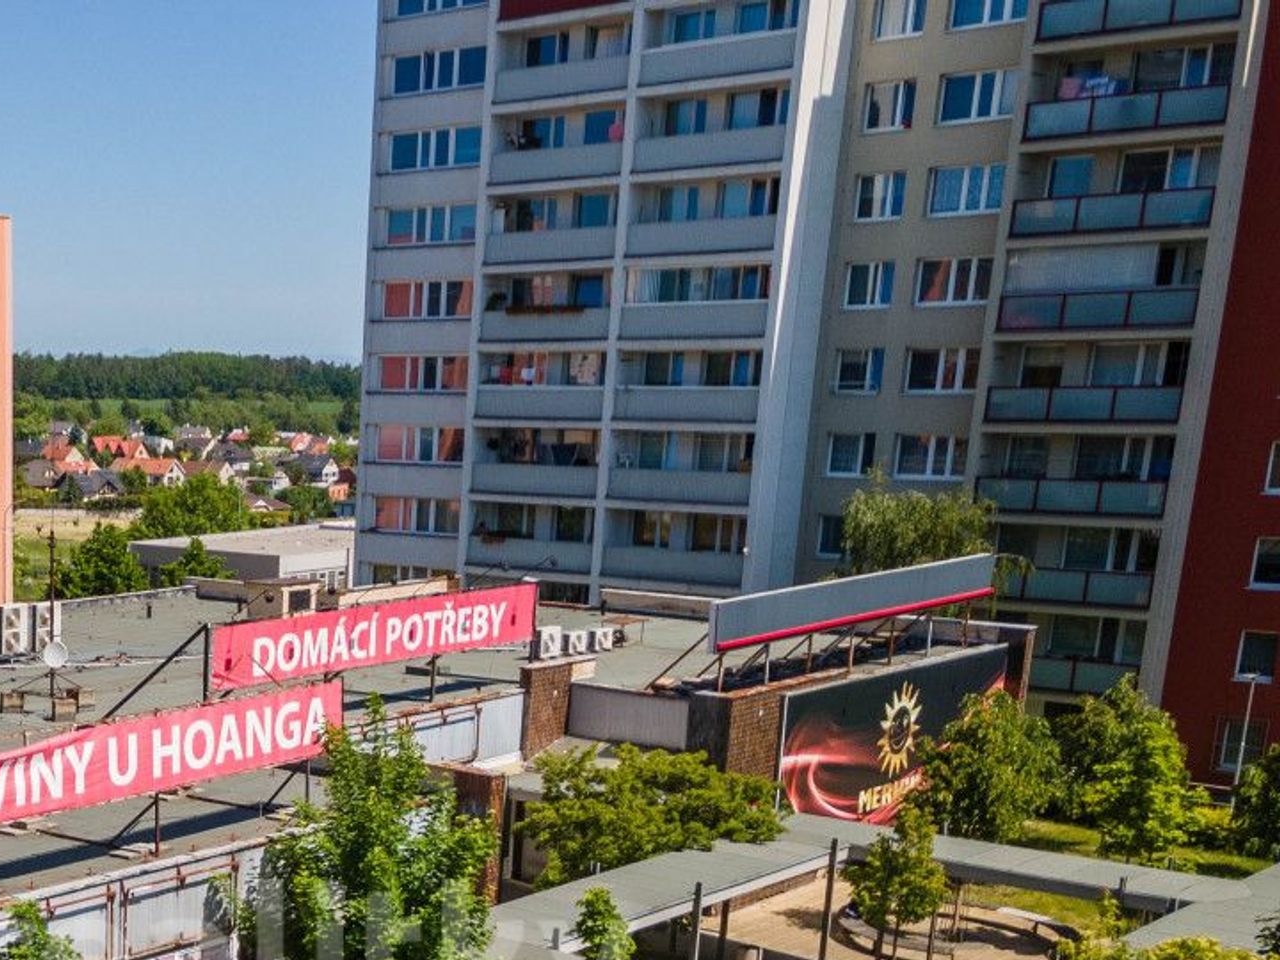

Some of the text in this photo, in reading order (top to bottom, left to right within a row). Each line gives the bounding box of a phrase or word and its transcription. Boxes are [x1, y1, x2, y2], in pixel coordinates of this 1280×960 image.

[251, 601, 508, 678] DOMÁCÍ POTŘEBY
[107, 733, 139, 787] U
[151, 696, 326, 779] HOANGA
